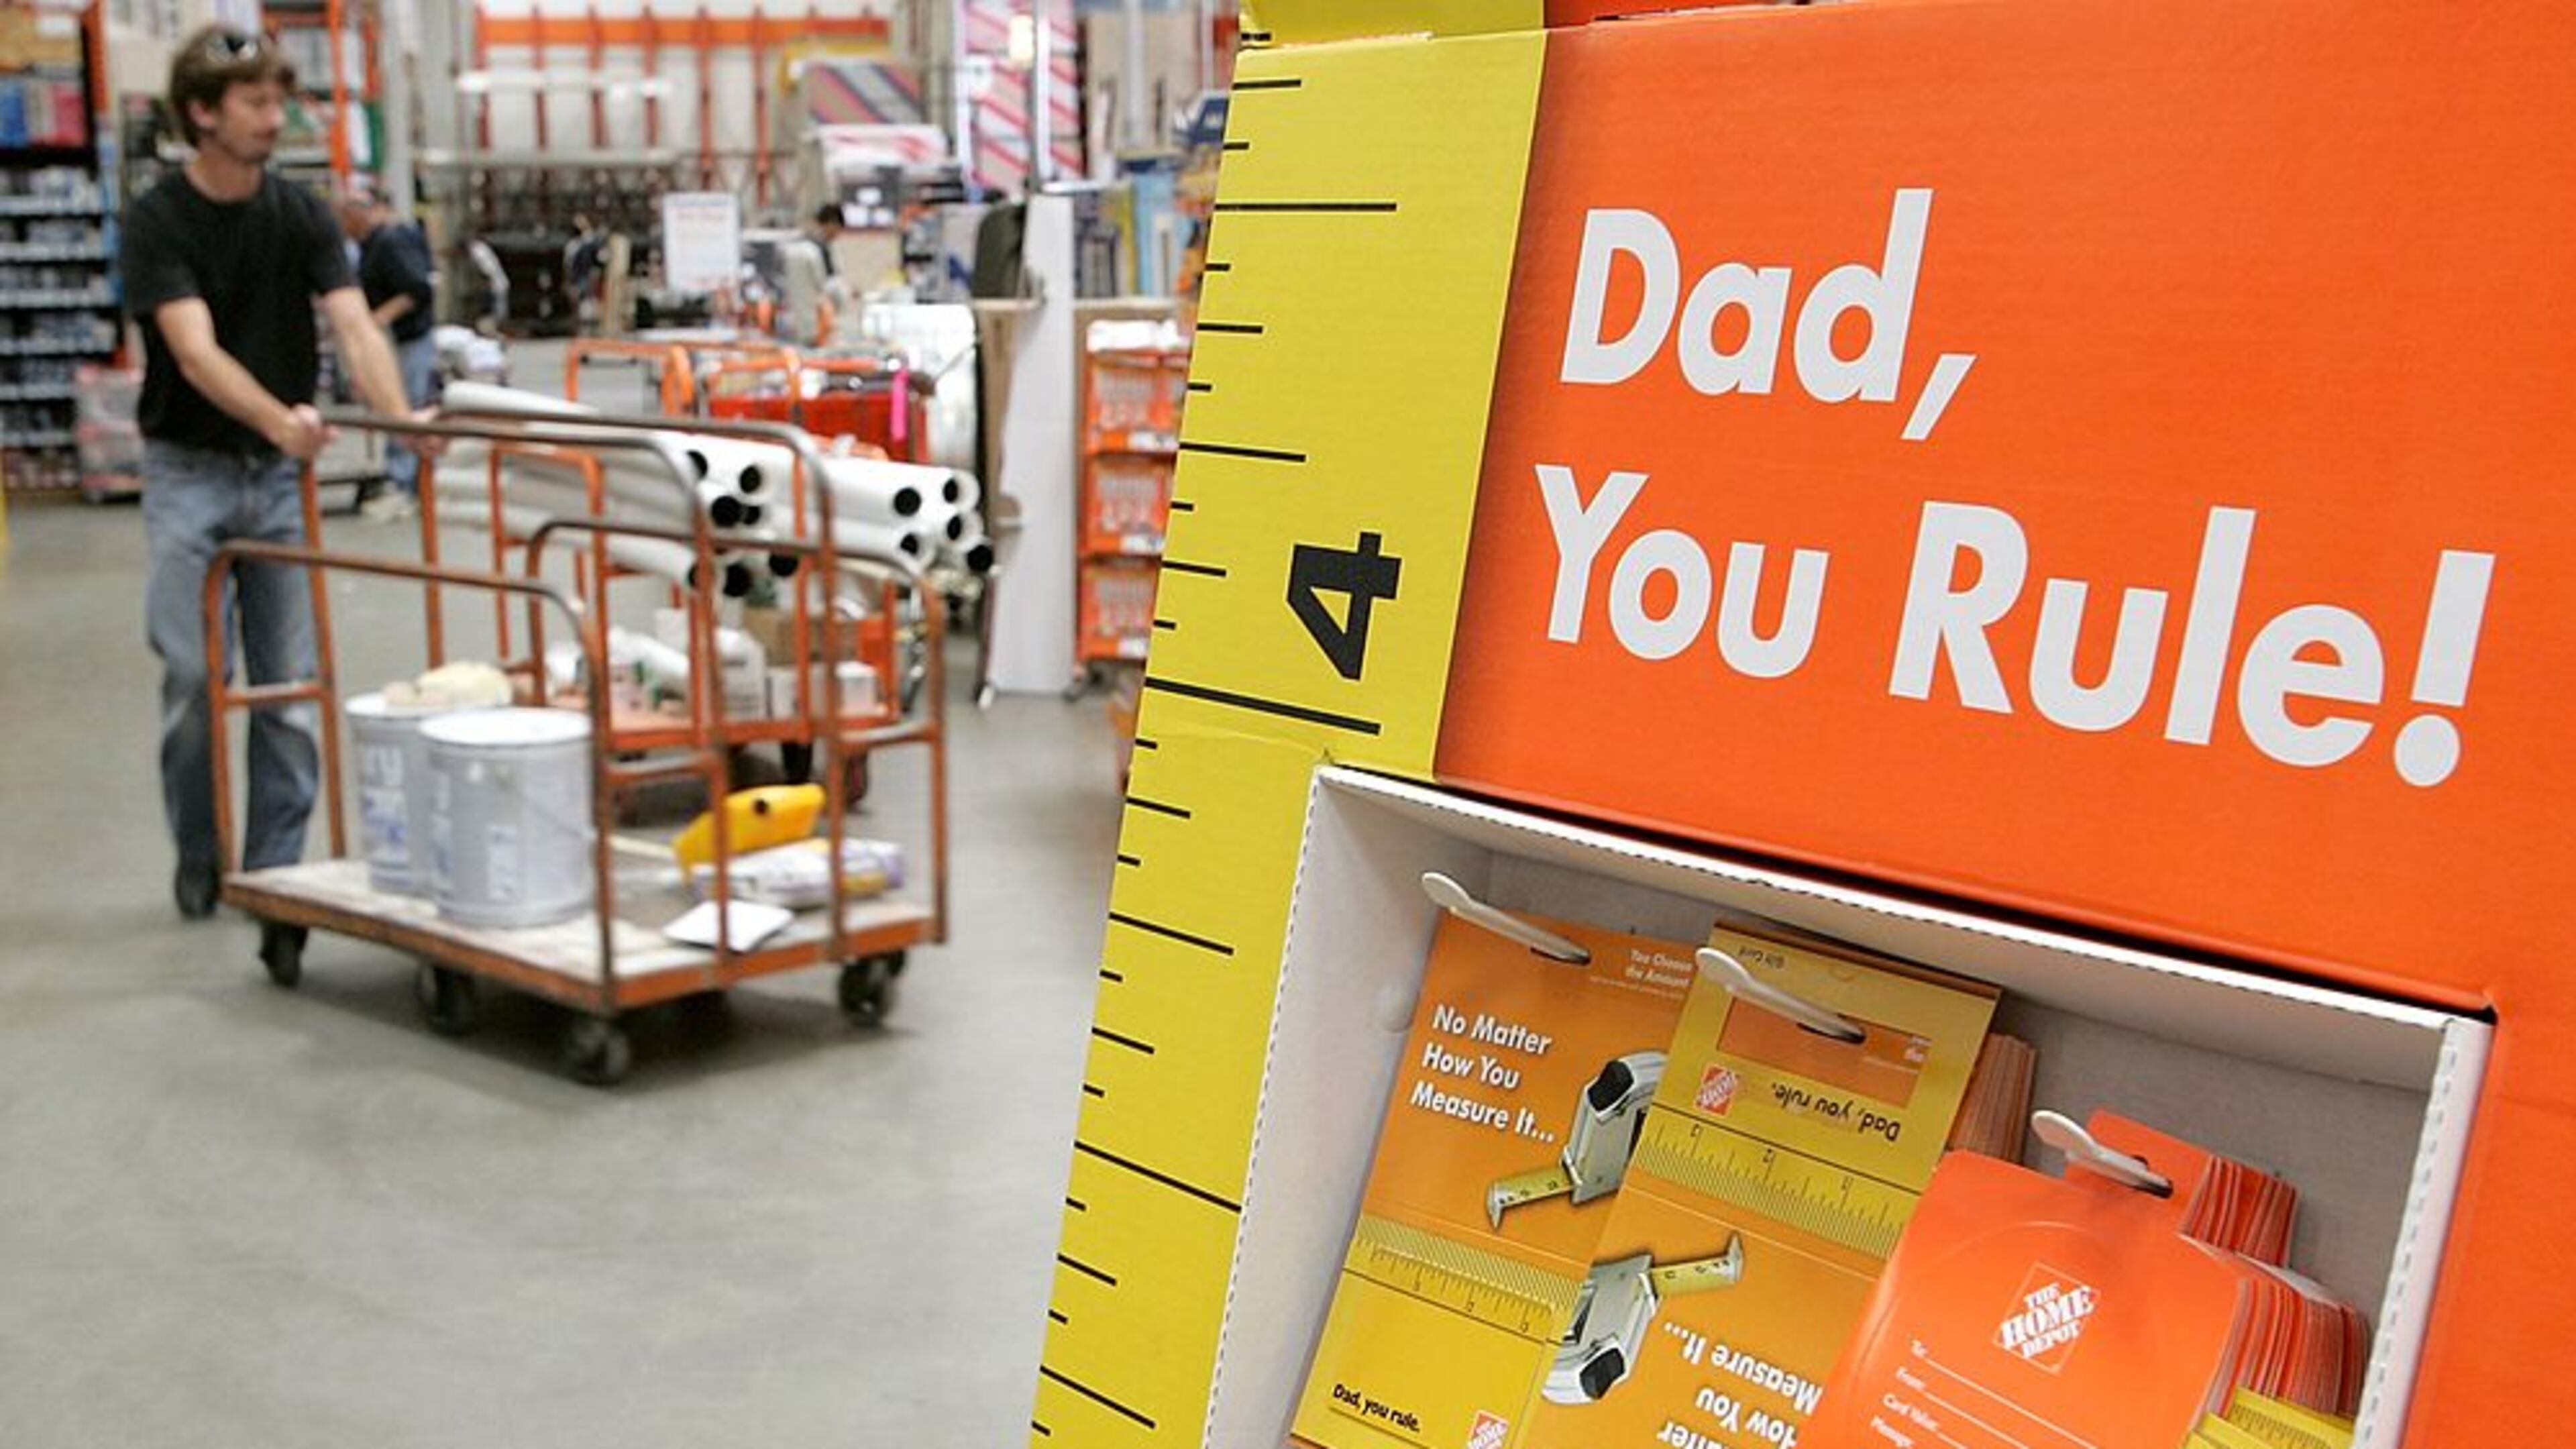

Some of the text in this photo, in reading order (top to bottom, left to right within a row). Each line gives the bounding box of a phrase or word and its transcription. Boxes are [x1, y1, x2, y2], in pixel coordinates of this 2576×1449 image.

[1561, 188, 1976, 441] Dad,
[1287, 532, 1401, 680] 4
[1536, 464, 2495, 786] You Rule!
[1432, 1004, 1553, 1055] No Matter
[1421, 1041, 1521, 1089] How You
[1410, 1079, 1554, 1142] Measure It...
[1771, 1081, 1901, 1142] Dad, you rule.
[2002, 1284, 2096, 1349] HOME
[2023, 1282, 2060, 1309] THE
[1664, 1322, 1824, 1416] Measure It...
[2023, 1319, 2081, 1359] DEPOT
[1333, 1383, 1421, 1434] Dad, you rule.
[1695, 1387, 1741, 1433] You
